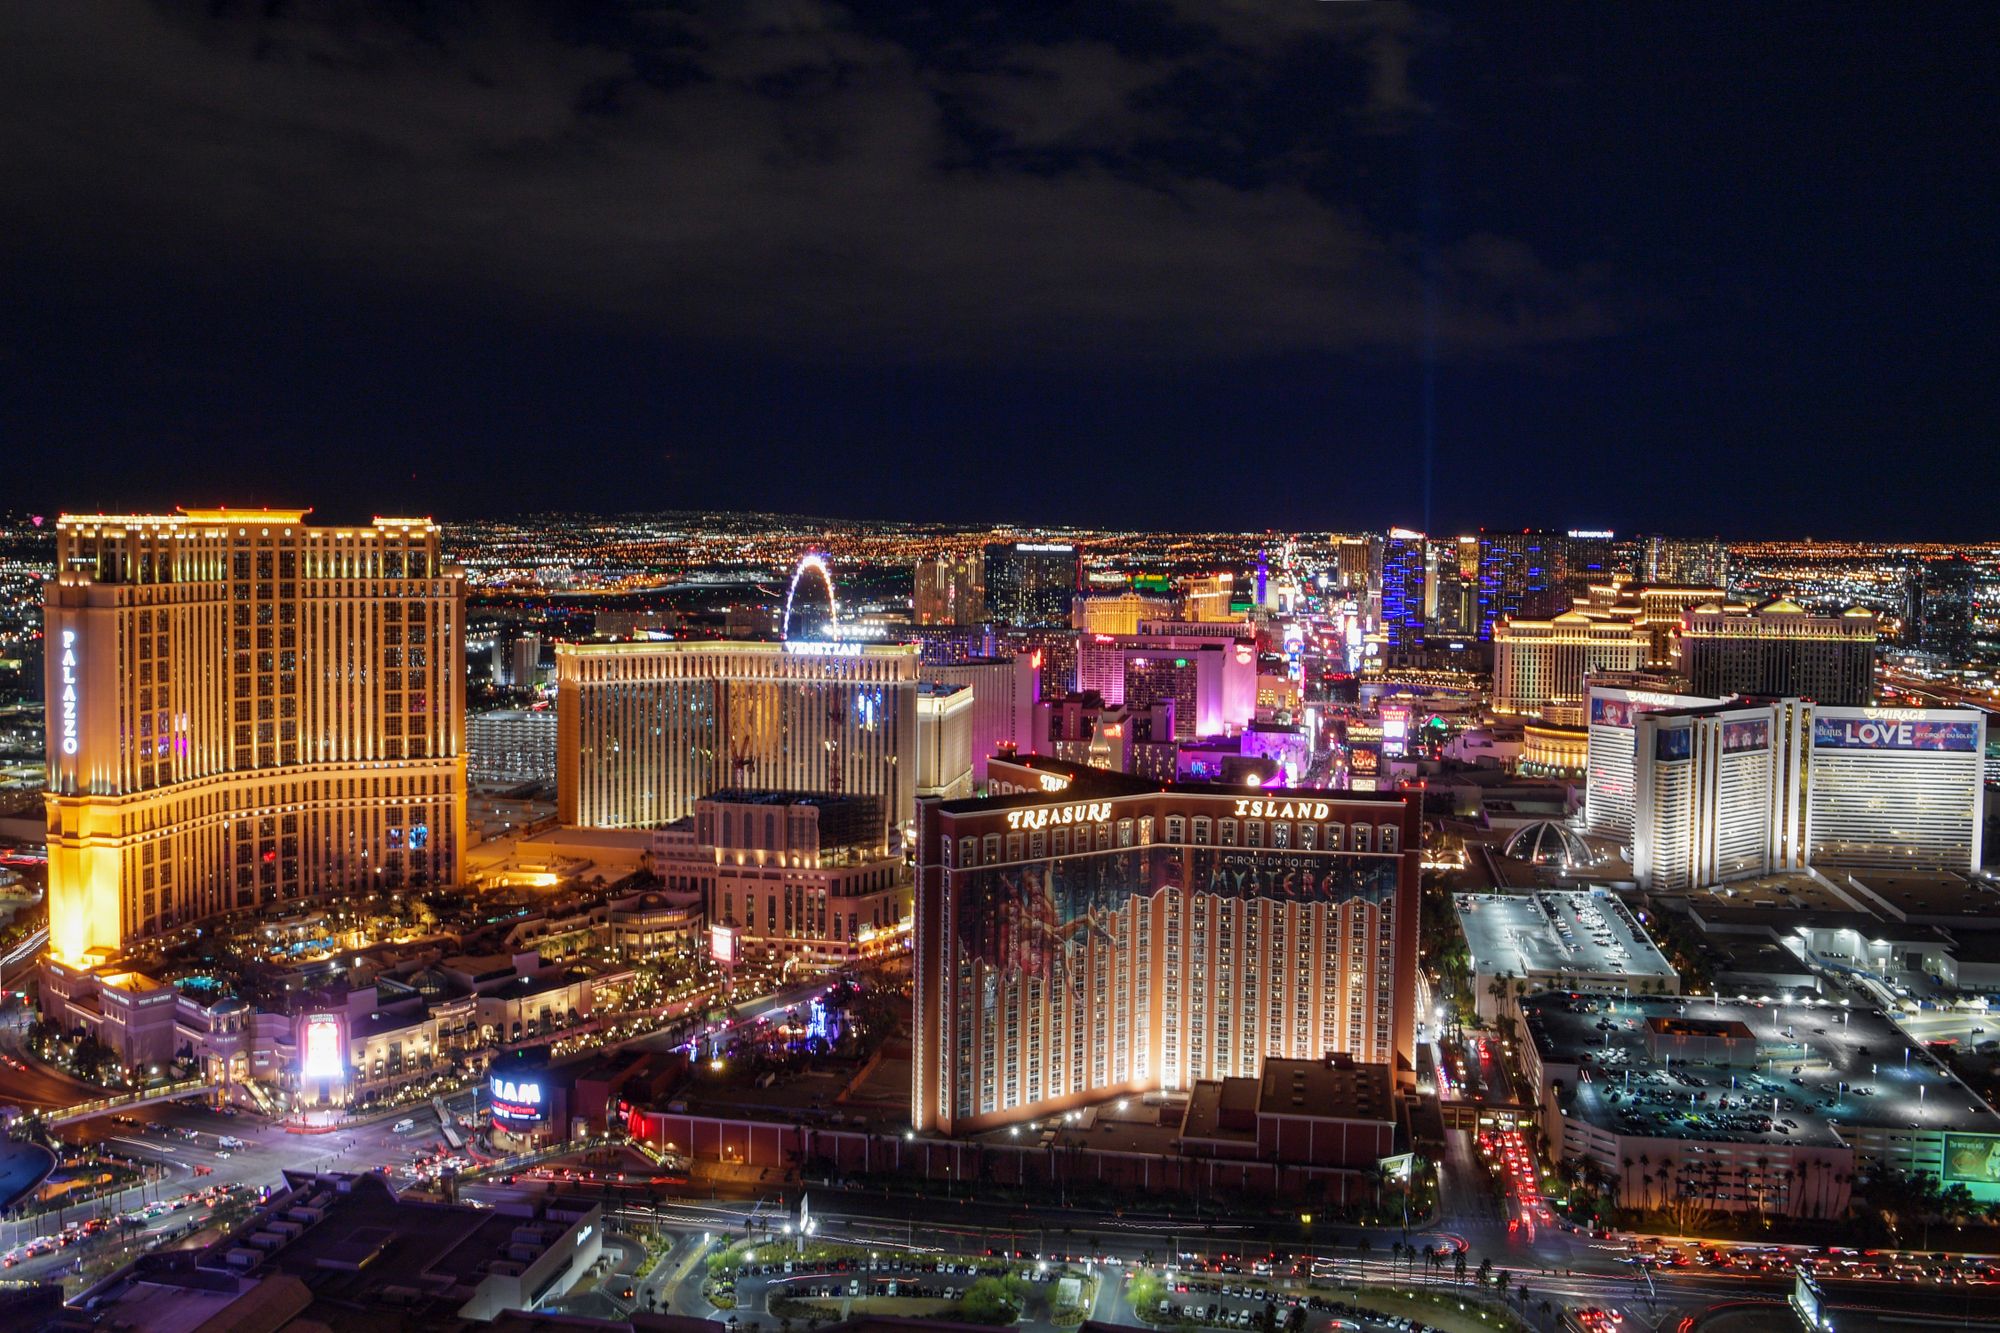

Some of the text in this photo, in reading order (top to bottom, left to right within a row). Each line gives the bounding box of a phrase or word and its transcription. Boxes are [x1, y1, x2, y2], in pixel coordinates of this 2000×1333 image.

[785, 642, 861, 656] VENETIAN
[62, 631, 77, 754] PALAZZO
[1877, 709, 1927, 721] MIRAGE
[1846, 723, 1913, 745] LOVE
[1008, 803, 1112, 829] TREASURE
[1235, 800, 1329, 819] ISLAND
[1227, 855, 1320, 868] CIRQUE DU SOLEIL
